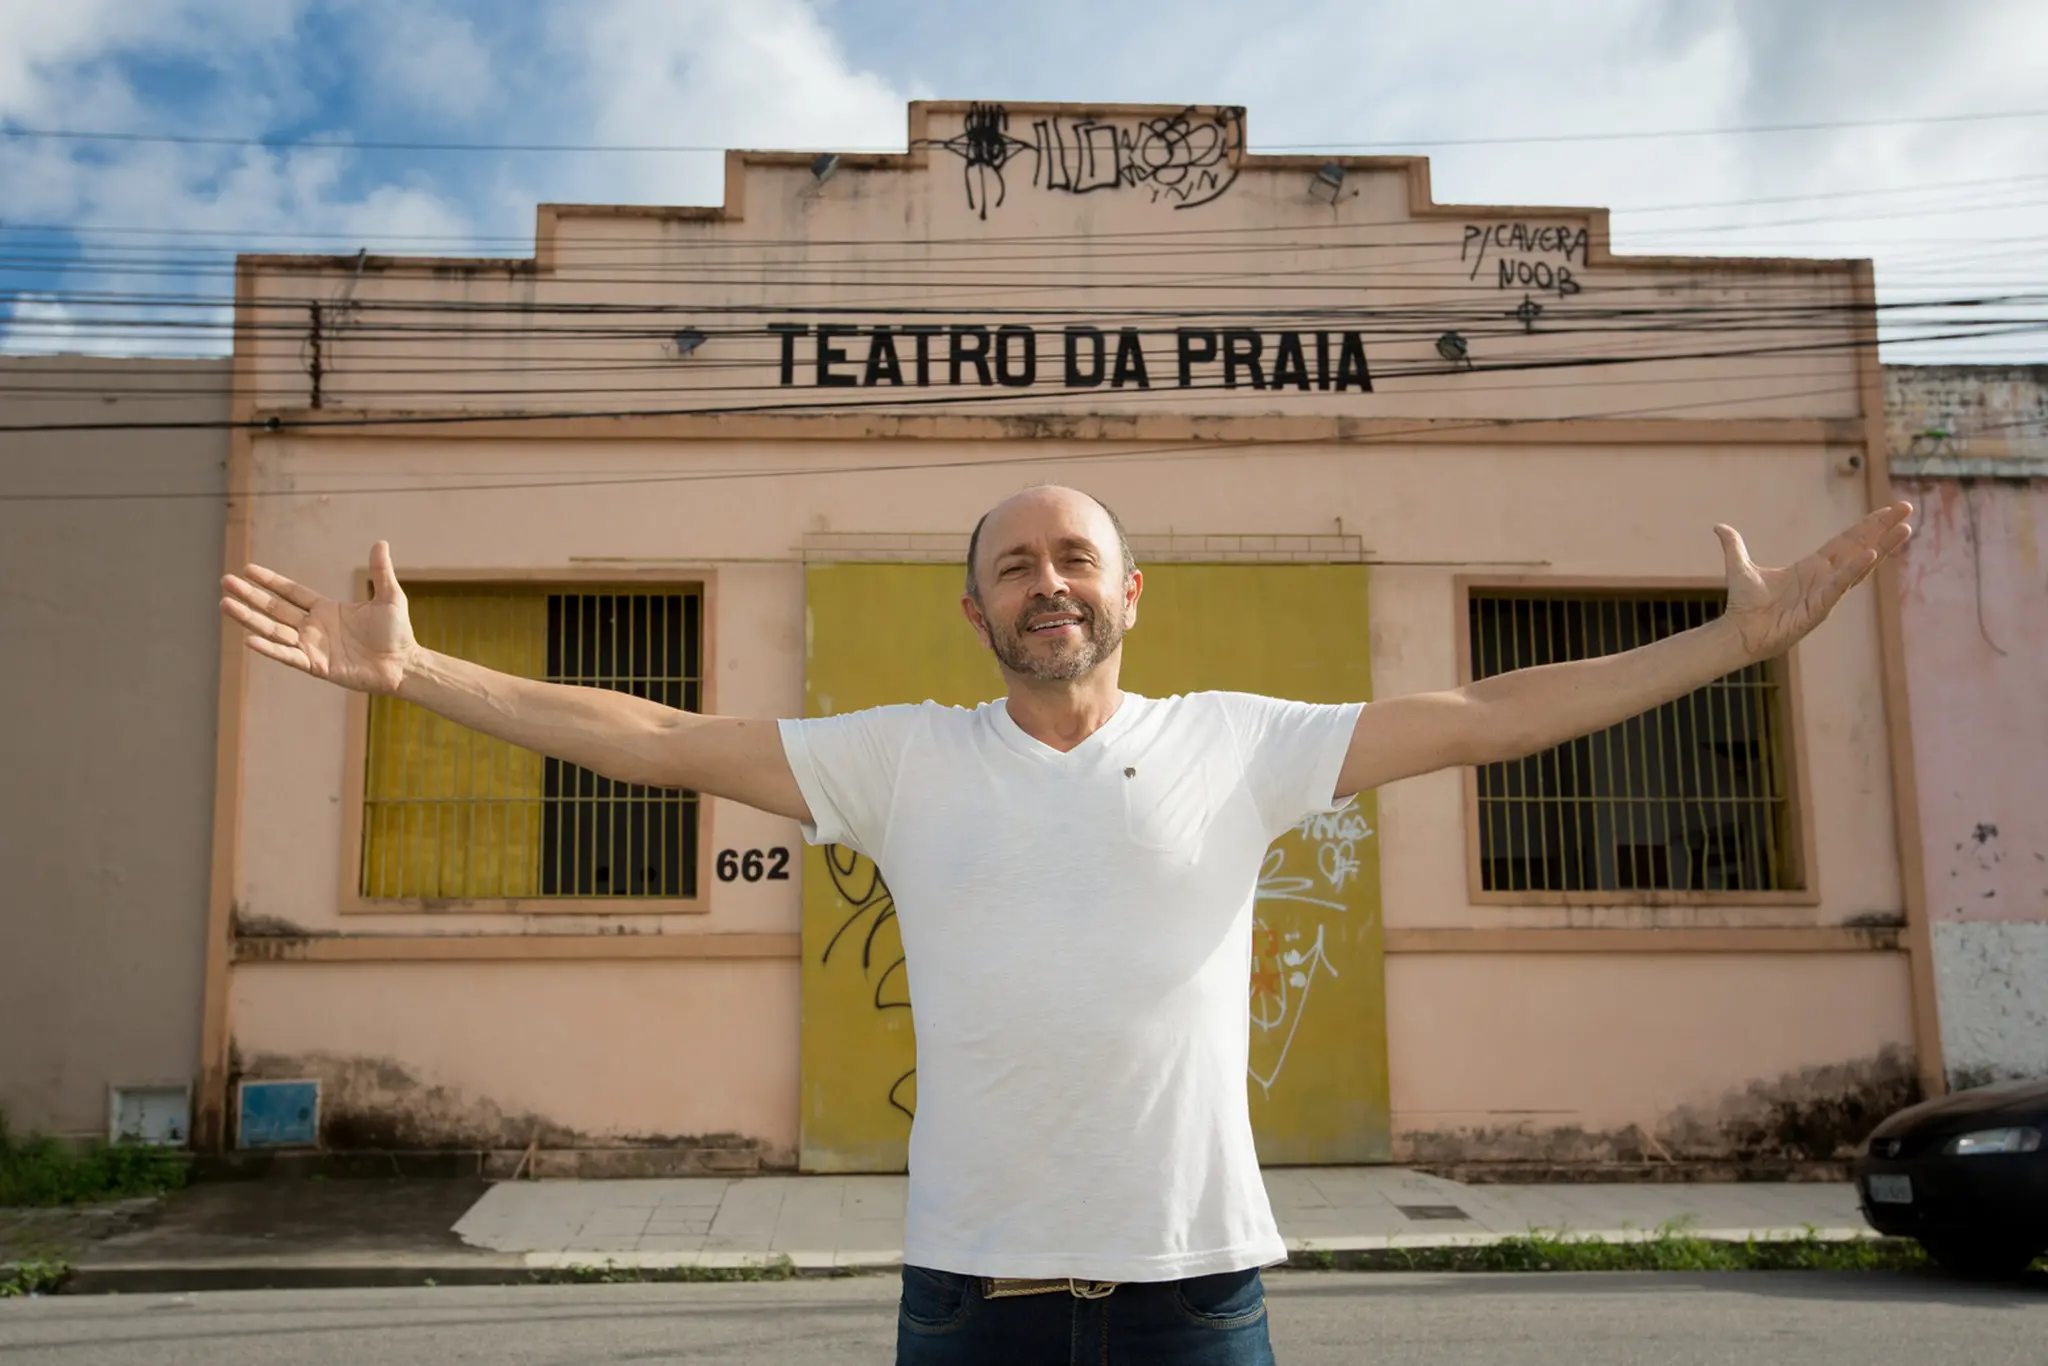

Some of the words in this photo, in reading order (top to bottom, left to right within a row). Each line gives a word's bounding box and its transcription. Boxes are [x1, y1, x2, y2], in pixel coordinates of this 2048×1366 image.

[1499, 258, 1580, 299] NOOB
[768, 323, 1036, 387] TEATRO
[1065, 326, 1151, 388] DA
[1177, 327, 1374, 392] PRAIA
[717, 847, 790, 882] 662
